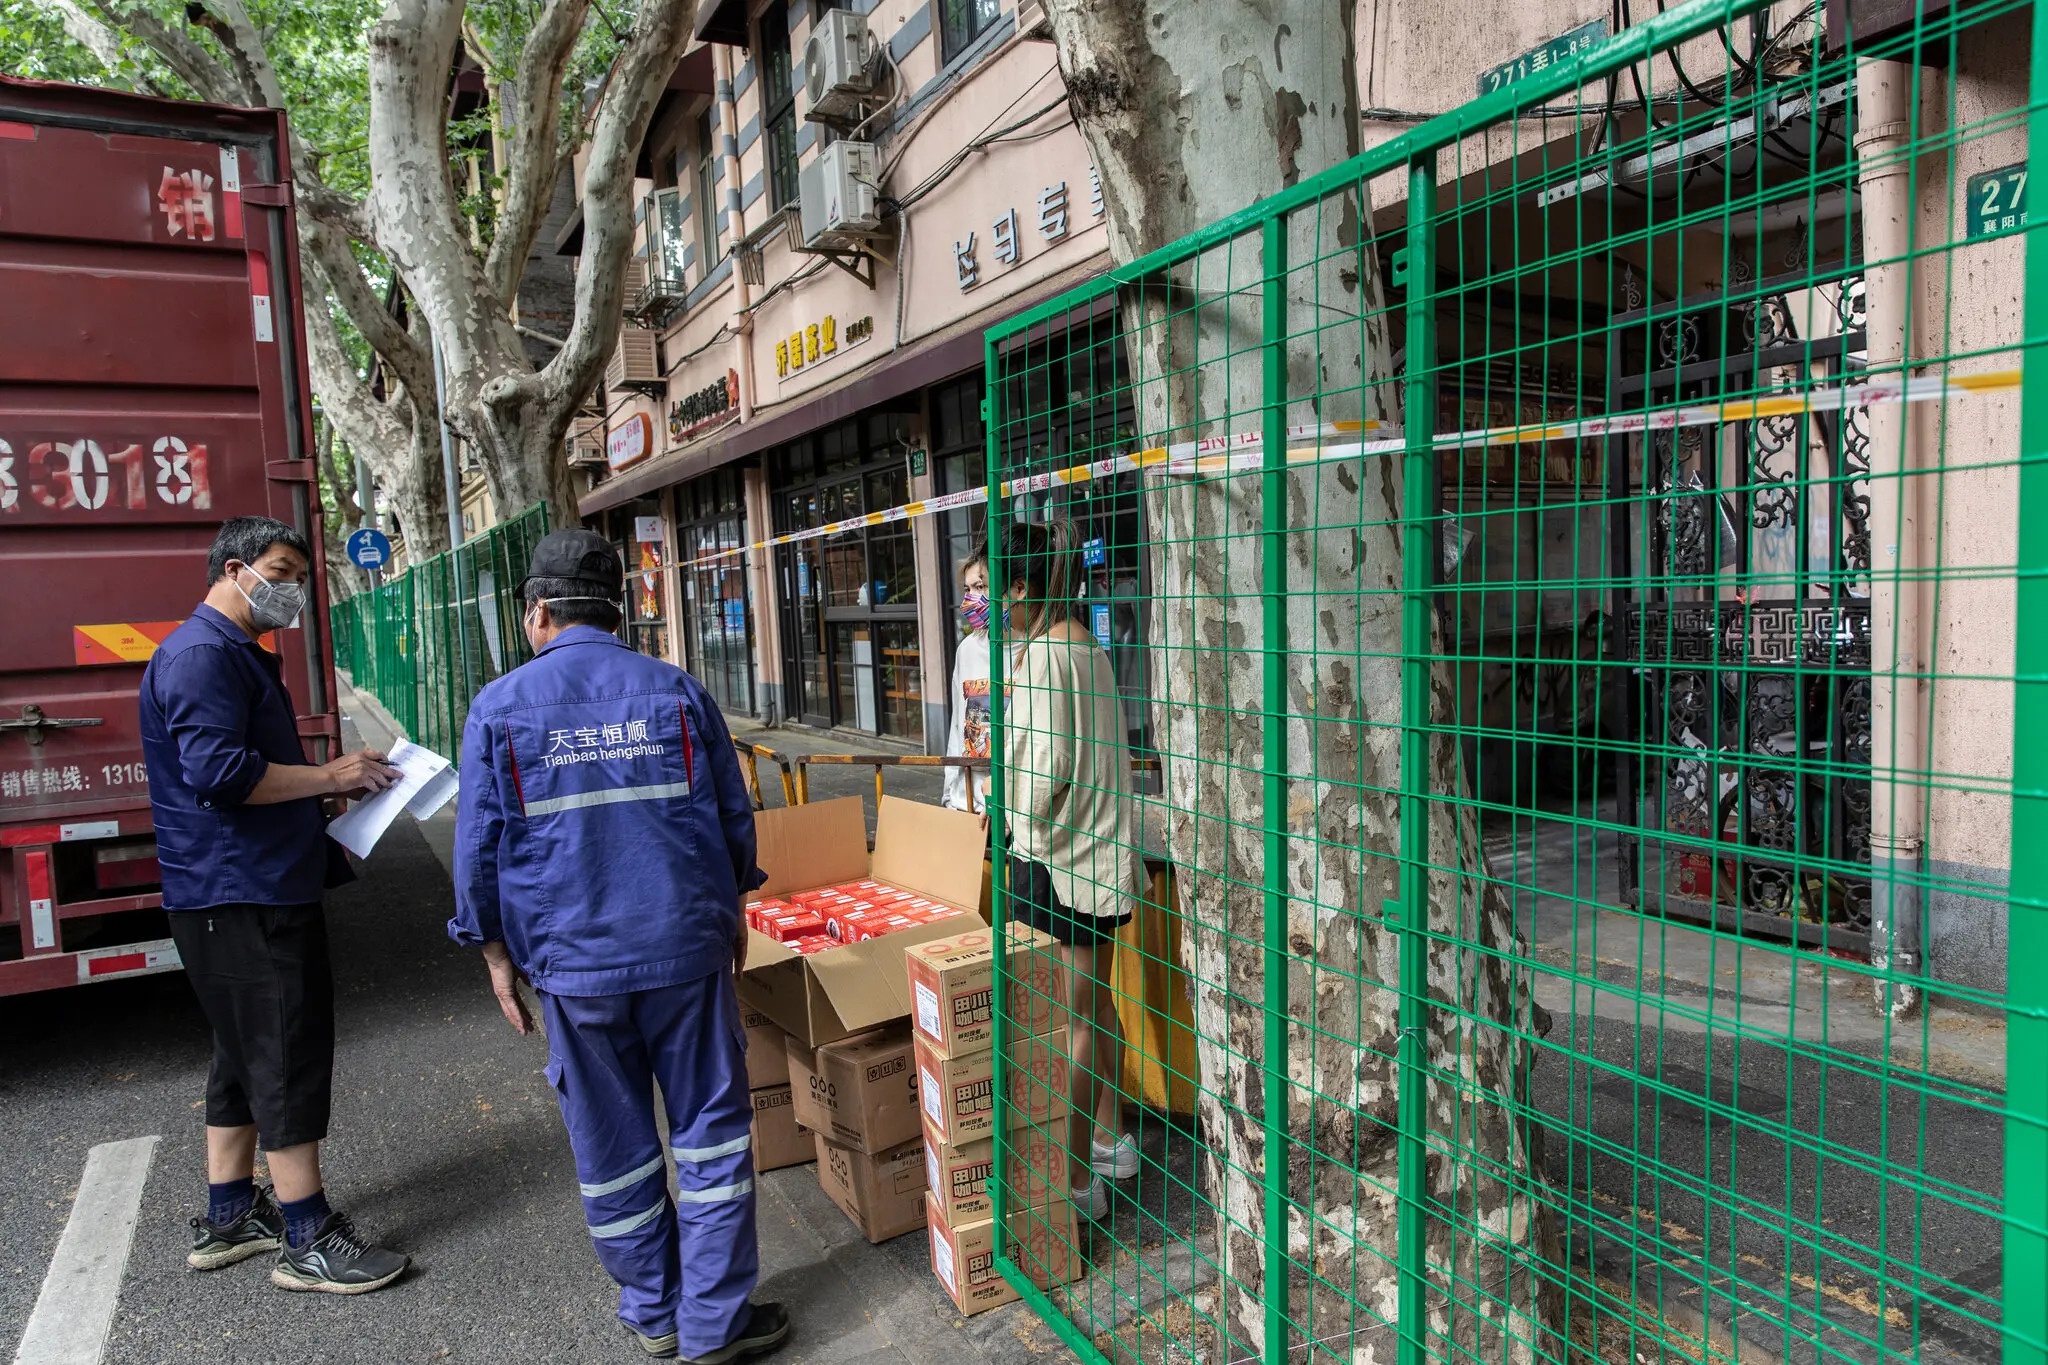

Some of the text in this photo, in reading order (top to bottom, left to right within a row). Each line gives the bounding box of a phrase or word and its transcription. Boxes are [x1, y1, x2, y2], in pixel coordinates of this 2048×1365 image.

[157, 166, 214, 241] 销
[121, 637, 135, 645] 3M
[549, 719, 649, 752] 天宝恒顺
[540, 743, 664, 769] Tianbao hengshun
[953, 990, 993, 1013] 田川
[955, 1008, 993, 1027] 咖喱
[955, 1078, 993, 1101] 田川
[956, 1095, 993, 1115] 咖喱
[952, 1163, 993, 1184] 田川
